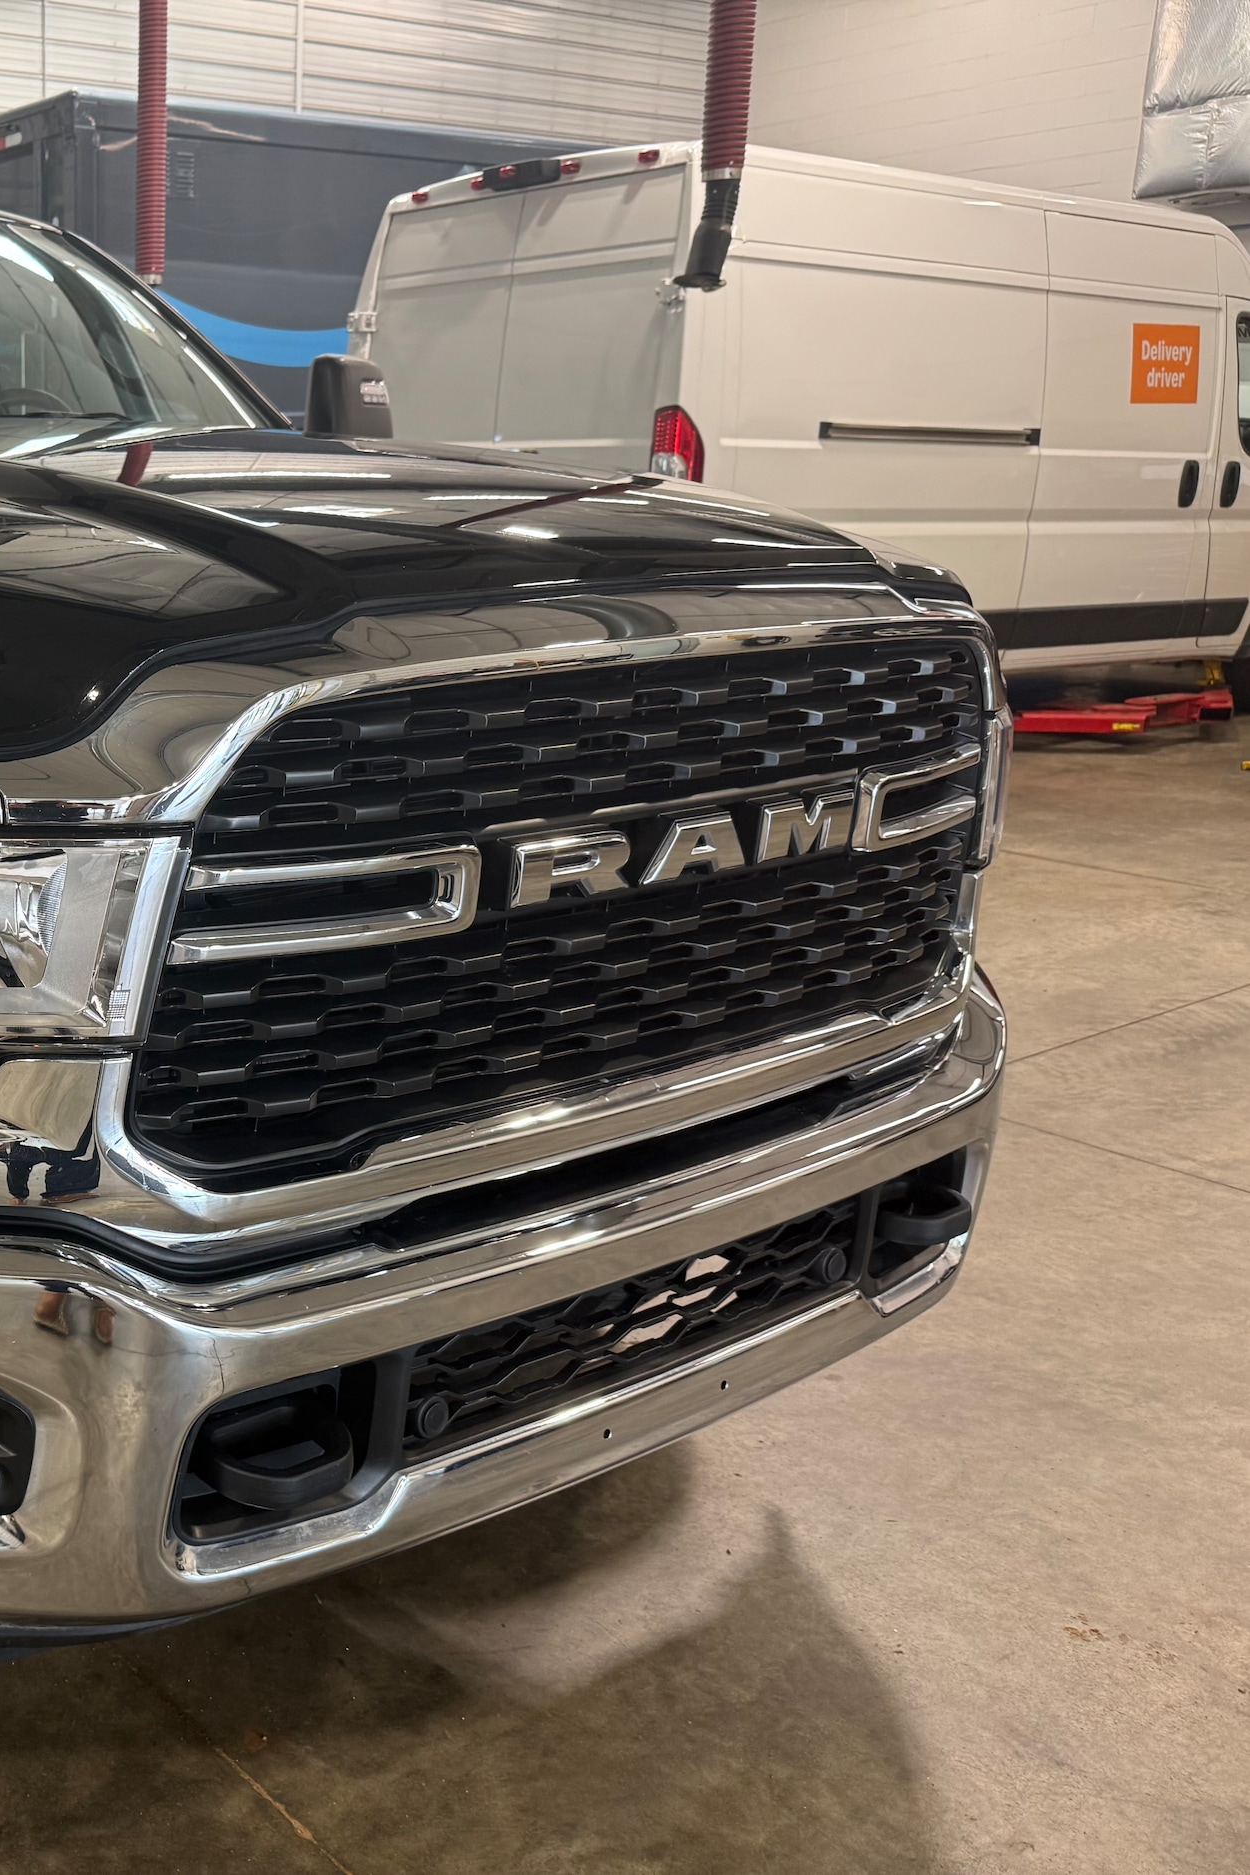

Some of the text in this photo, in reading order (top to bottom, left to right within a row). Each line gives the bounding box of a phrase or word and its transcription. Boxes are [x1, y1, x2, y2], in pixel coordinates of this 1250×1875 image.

[1141, 340, 1193, 366] Delivery
[1146, 366, 1186, 388] driver
[506, 790, 855, 910] RAM
